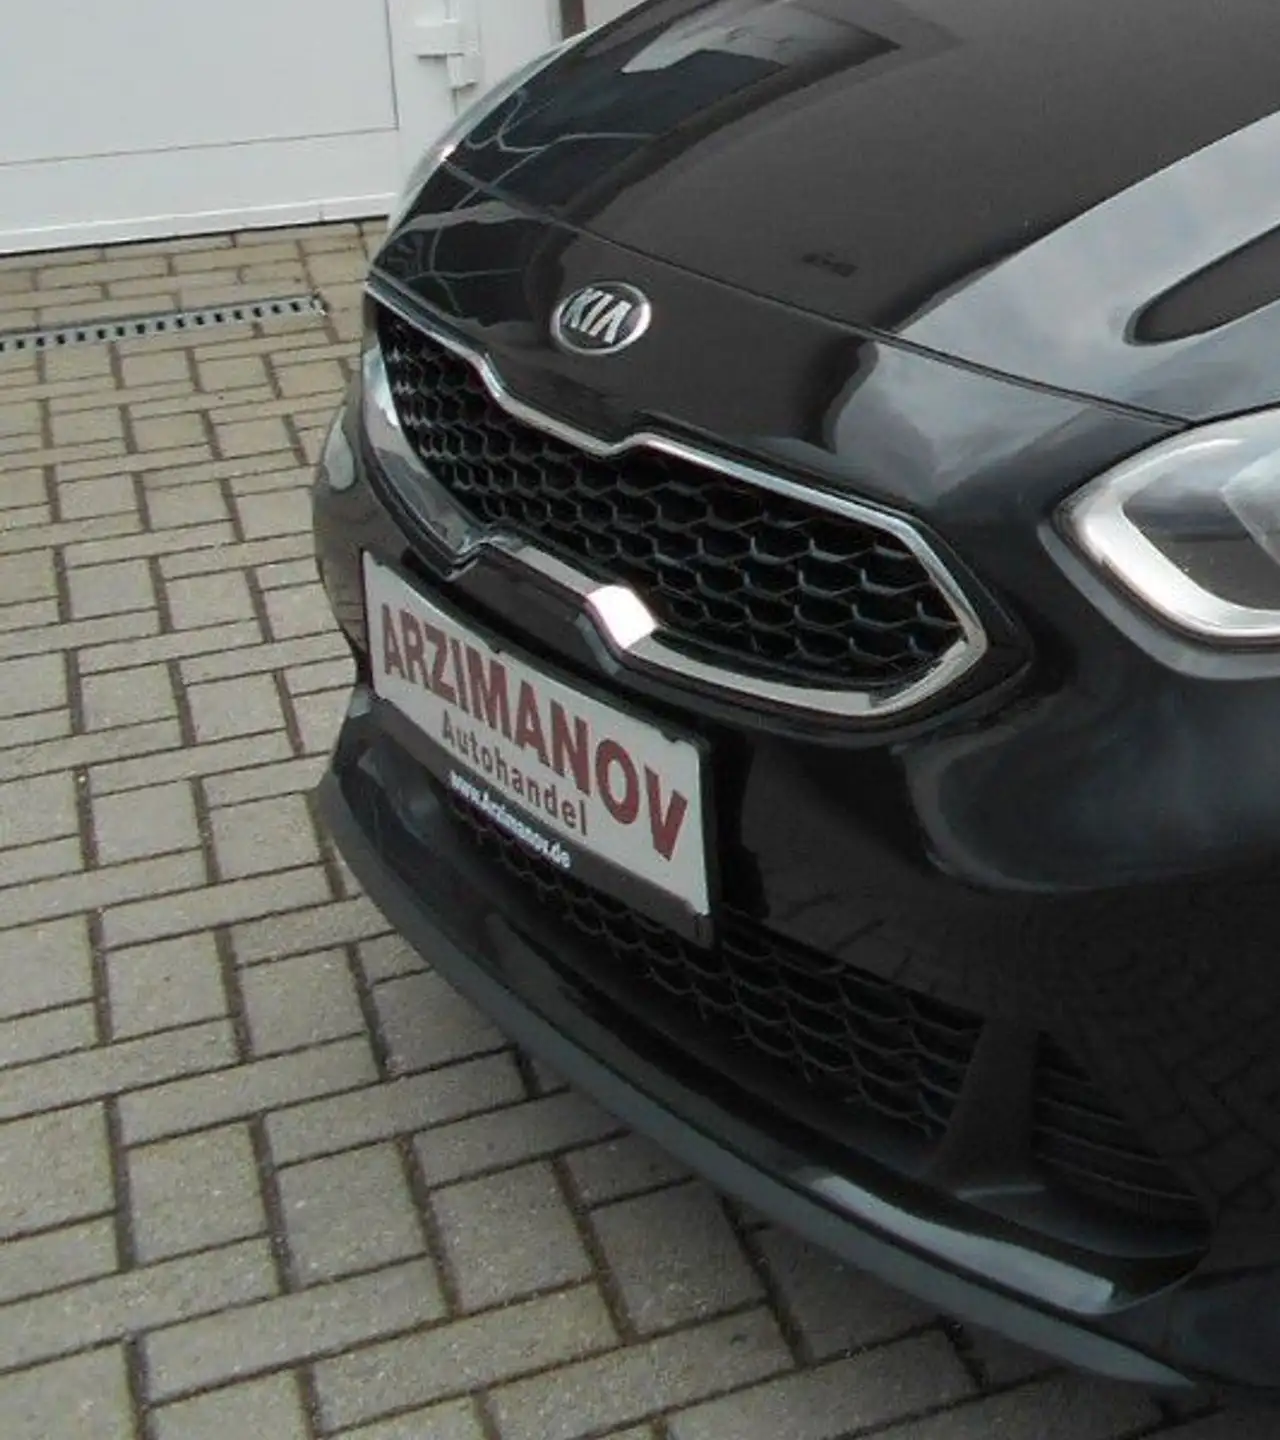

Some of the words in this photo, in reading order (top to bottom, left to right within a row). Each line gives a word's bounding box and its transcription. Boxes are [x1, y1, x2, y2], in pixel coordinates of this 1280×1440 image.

[560, 287, 632, 344] KIA
[381, 603, 688, 861] ARZIMANOV
[441, 710, 588, 836] Autohandel
